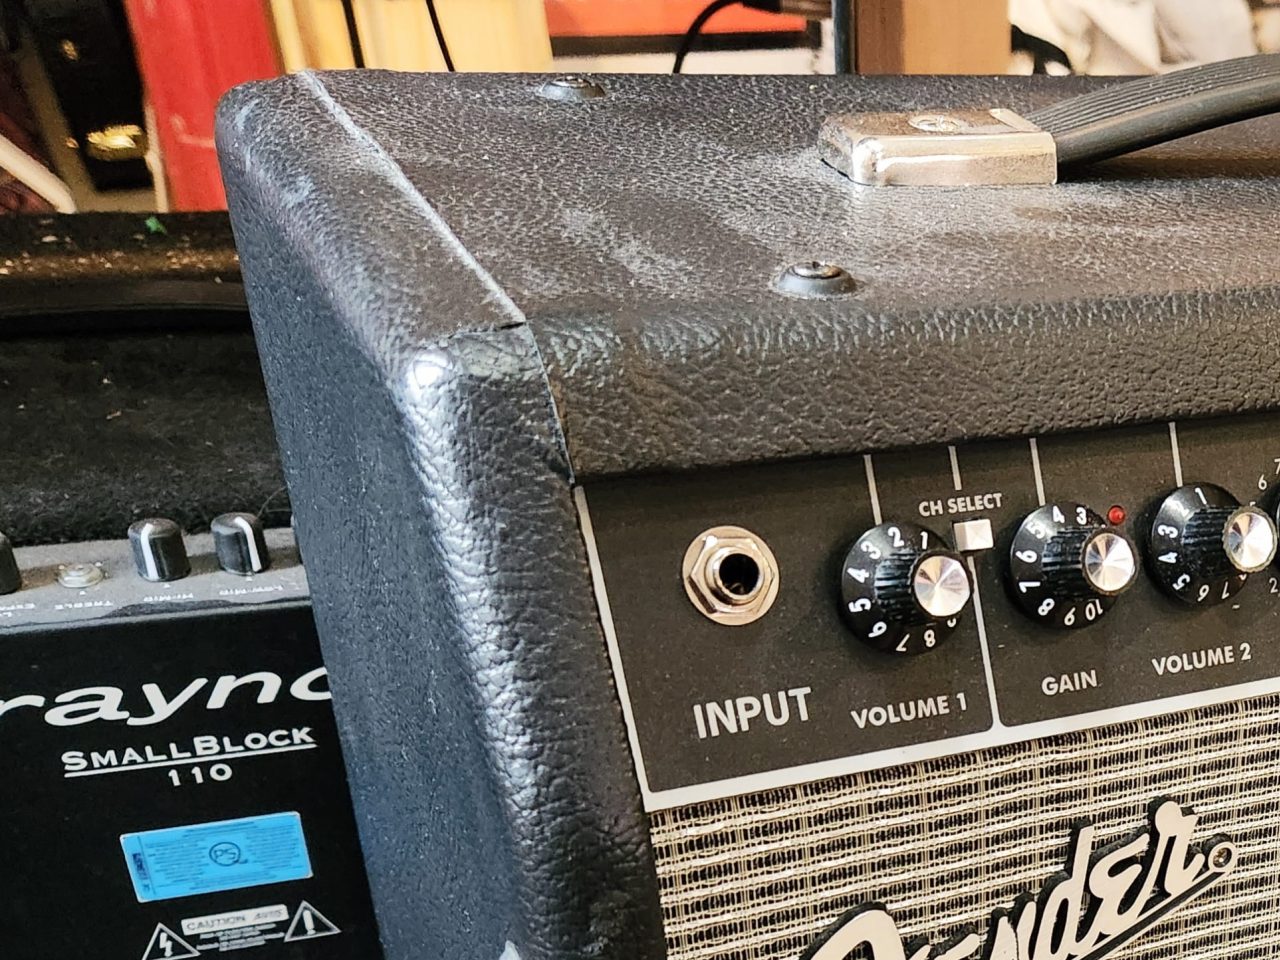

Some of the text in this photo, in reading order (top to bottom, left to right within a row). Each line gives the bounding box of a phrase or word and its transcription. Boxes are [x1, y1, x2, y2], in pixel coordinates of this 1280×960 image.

[1258, 474, 1268, 490] 6
[918, 493, 1003, 517] CH SELECT
[1195, 487, 1207, 505] 1
[1052, 506, 1065, 523] 4
[1076, 506, 1087, 525] 3
[887, 526, 905, 547] 2
[1025, 521, 1046, 539] 5
[1157, 524, 1178, 538] 3
[920, 531, 928, 550] 1
[860, 541, 881, 559] 3
[1015, 550, 1038, 563] 6
[1158, 552, 1178, 564] 4
[847, 567, 869, 583] 4
[1172, 573, 1190, 591] 5
[1269, 577, 1278, 594] 2
[848, 598, 871, 612] 5
[1038, 598, 1055, 616] 8
[1085, 599, 1103, 620] 10
[896, 633, 910, 652] 7
[924, 629, 936, 647] 8
[1152, 642, 1252, 676] VOLUME 2
[1041, 670, 1098, 696] GAIN
[692, 686, 812, 739] INPUT
[851, 692, 967, 729] VOLUME 1
[168, 763, 233, 787] 110
[187, 916, 245, 931] CAUTION
